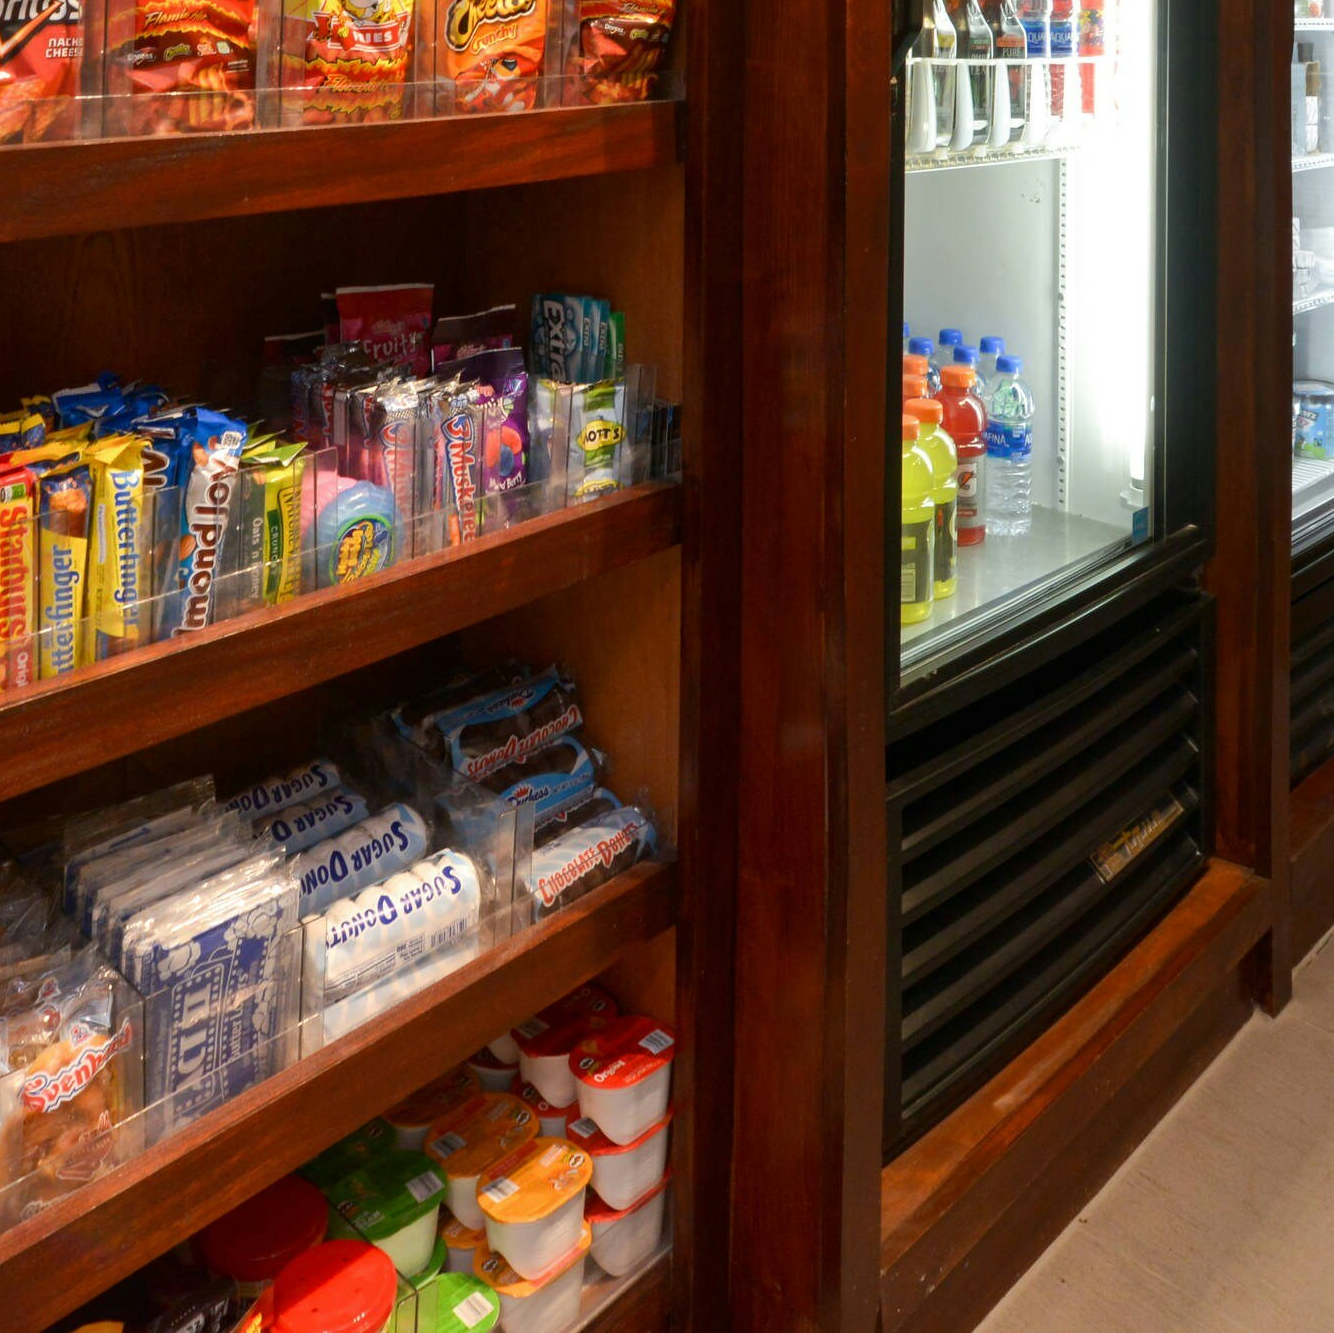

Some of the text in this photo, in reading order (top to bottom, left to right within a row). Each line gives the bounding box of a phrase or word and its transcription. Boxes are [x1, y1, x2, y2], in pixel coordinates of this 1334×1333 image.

[364, 331, 419, 359] Fruity
[442, 414, 471, 439] 3
[110, 469, 141, 627] Butterfinger
[252, 517, 264, 546] Oats
[52, 544, 81, 674] utterfinger
[293, 794, 354, 833] SUGAR
[351, 820, 409, 872] SUGAR
[538, 847, 597, 907] CHOCOLATE
[326, 865, 462, 950] SUGAR DONUT
